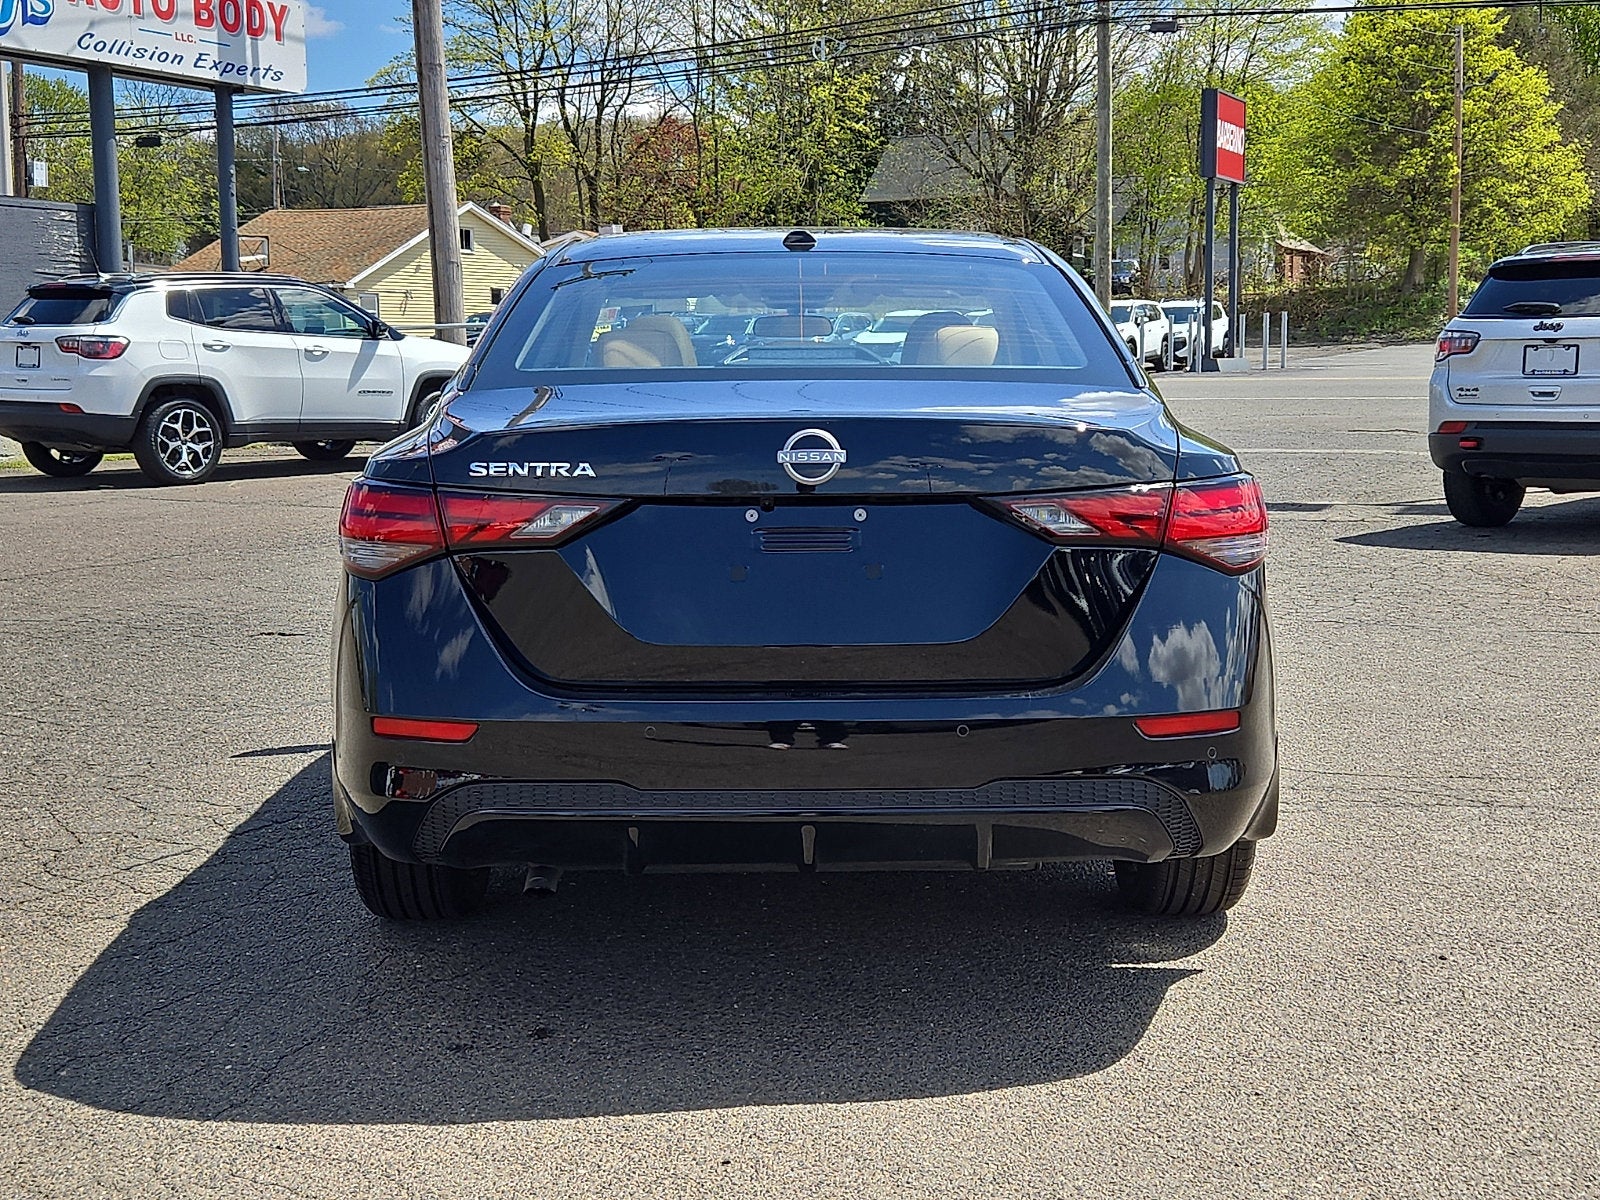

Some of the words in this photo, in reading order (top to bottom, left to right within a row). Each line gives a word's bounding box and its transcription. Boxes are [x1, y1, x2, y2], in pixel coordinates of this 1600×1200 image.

[193, 0, 289, 43] BODY
[175, 32, 197, 44] LLC.
[77, 32, 184, 65] Collision
[193, 52, 284, 81] Experts
[1533, 321, 1564, 332] Jeep
[779, 452, 845, 462] NISSAN
[468, 461, 597, 478] SENTRA
